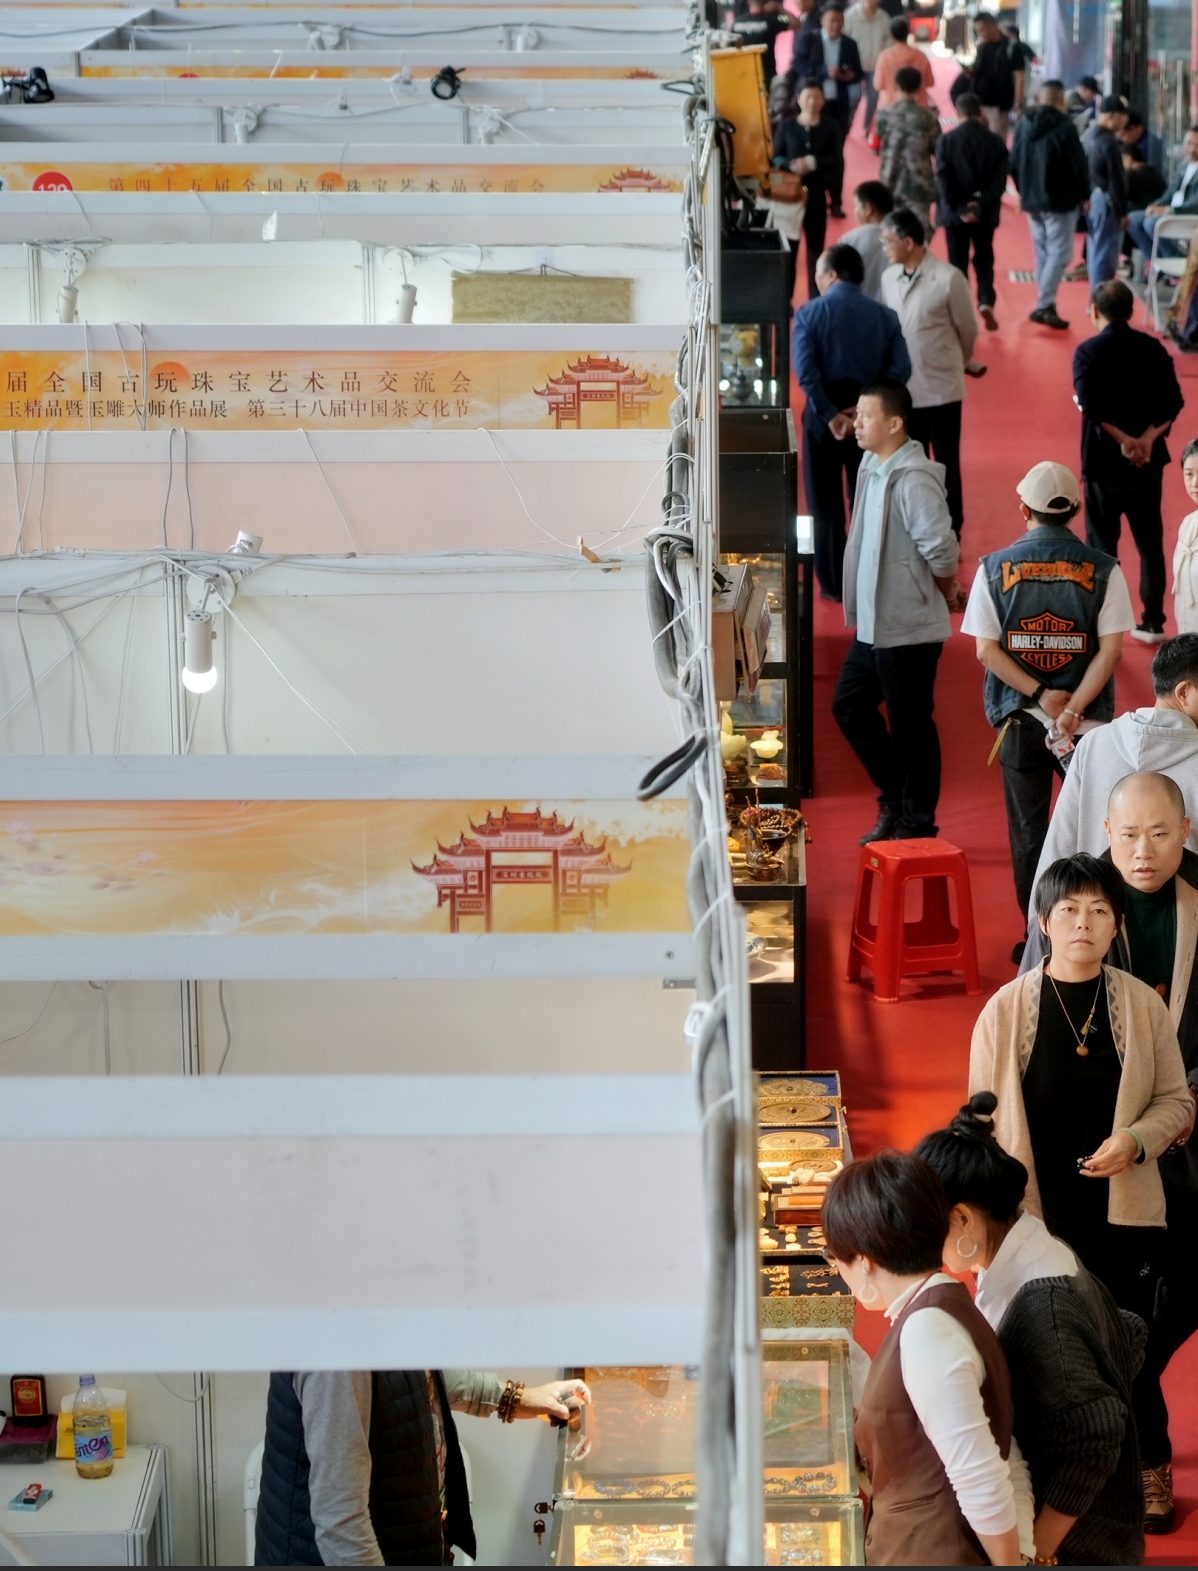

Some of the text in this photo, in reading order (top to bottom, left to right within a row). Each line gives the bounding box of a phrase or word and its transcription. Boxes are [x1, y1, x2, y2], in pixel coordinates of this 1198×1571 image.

[6, 370, 471, 393] 届全国古玩珠宝艺术品交流会
[247, 399, 470, 418] 第三十八届中国茶文化节
[1027, 616, 1067, 632] MOTOR
[1011, 634, 1083, 650] HARLEY-DAVIDSON
[1027, 652, 1066, 669] CYCLES
